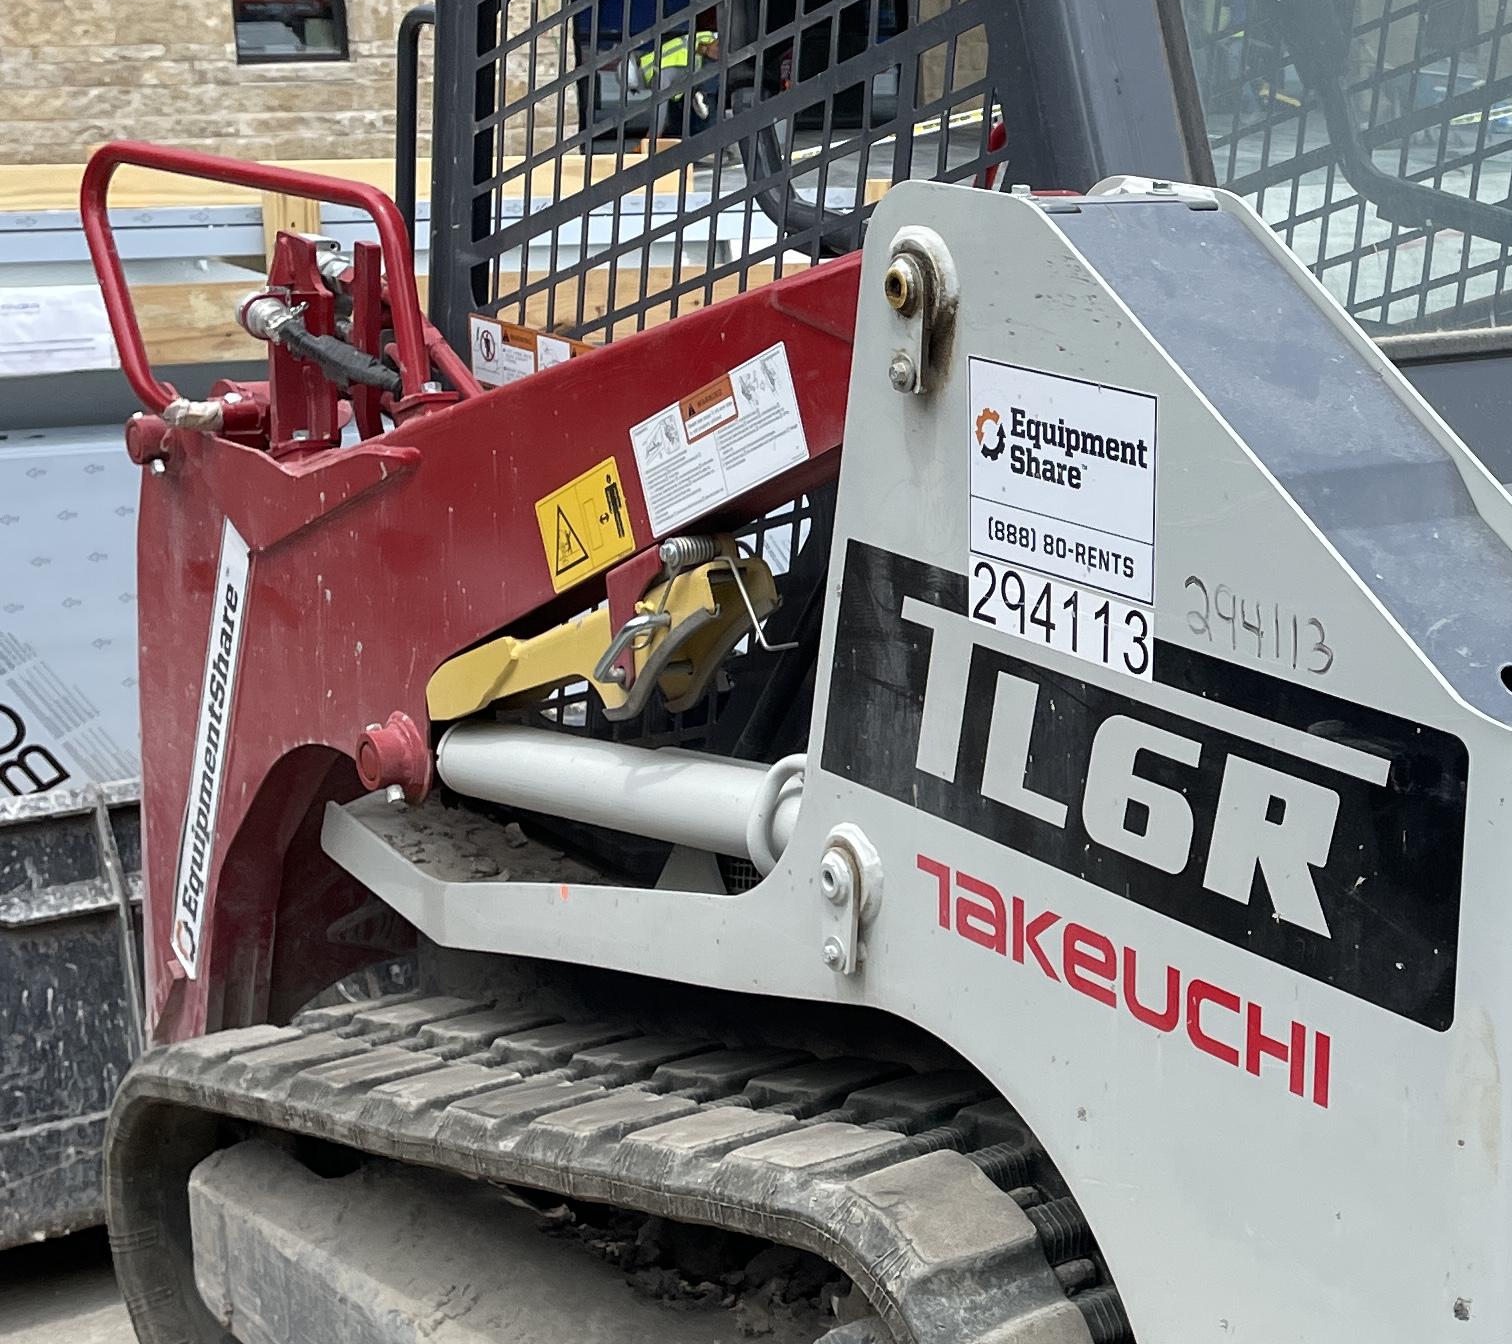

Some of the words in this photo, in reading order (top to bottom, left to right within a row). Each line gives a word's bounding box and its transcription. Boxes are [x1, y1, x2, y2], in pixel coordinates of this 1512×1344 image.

[1010, 407, 1149, 469] Equipment
[987, 515, 1037, 553] (888)
[1043, 533, 1135, 579] 80-RENTS
[972, 561, 1150, 675] 294113
[1184, 575, 1334, 675] 294113
[180, 582, 238, 924] EquipmentShare
[901, 595, 1391, 940] TL6R
